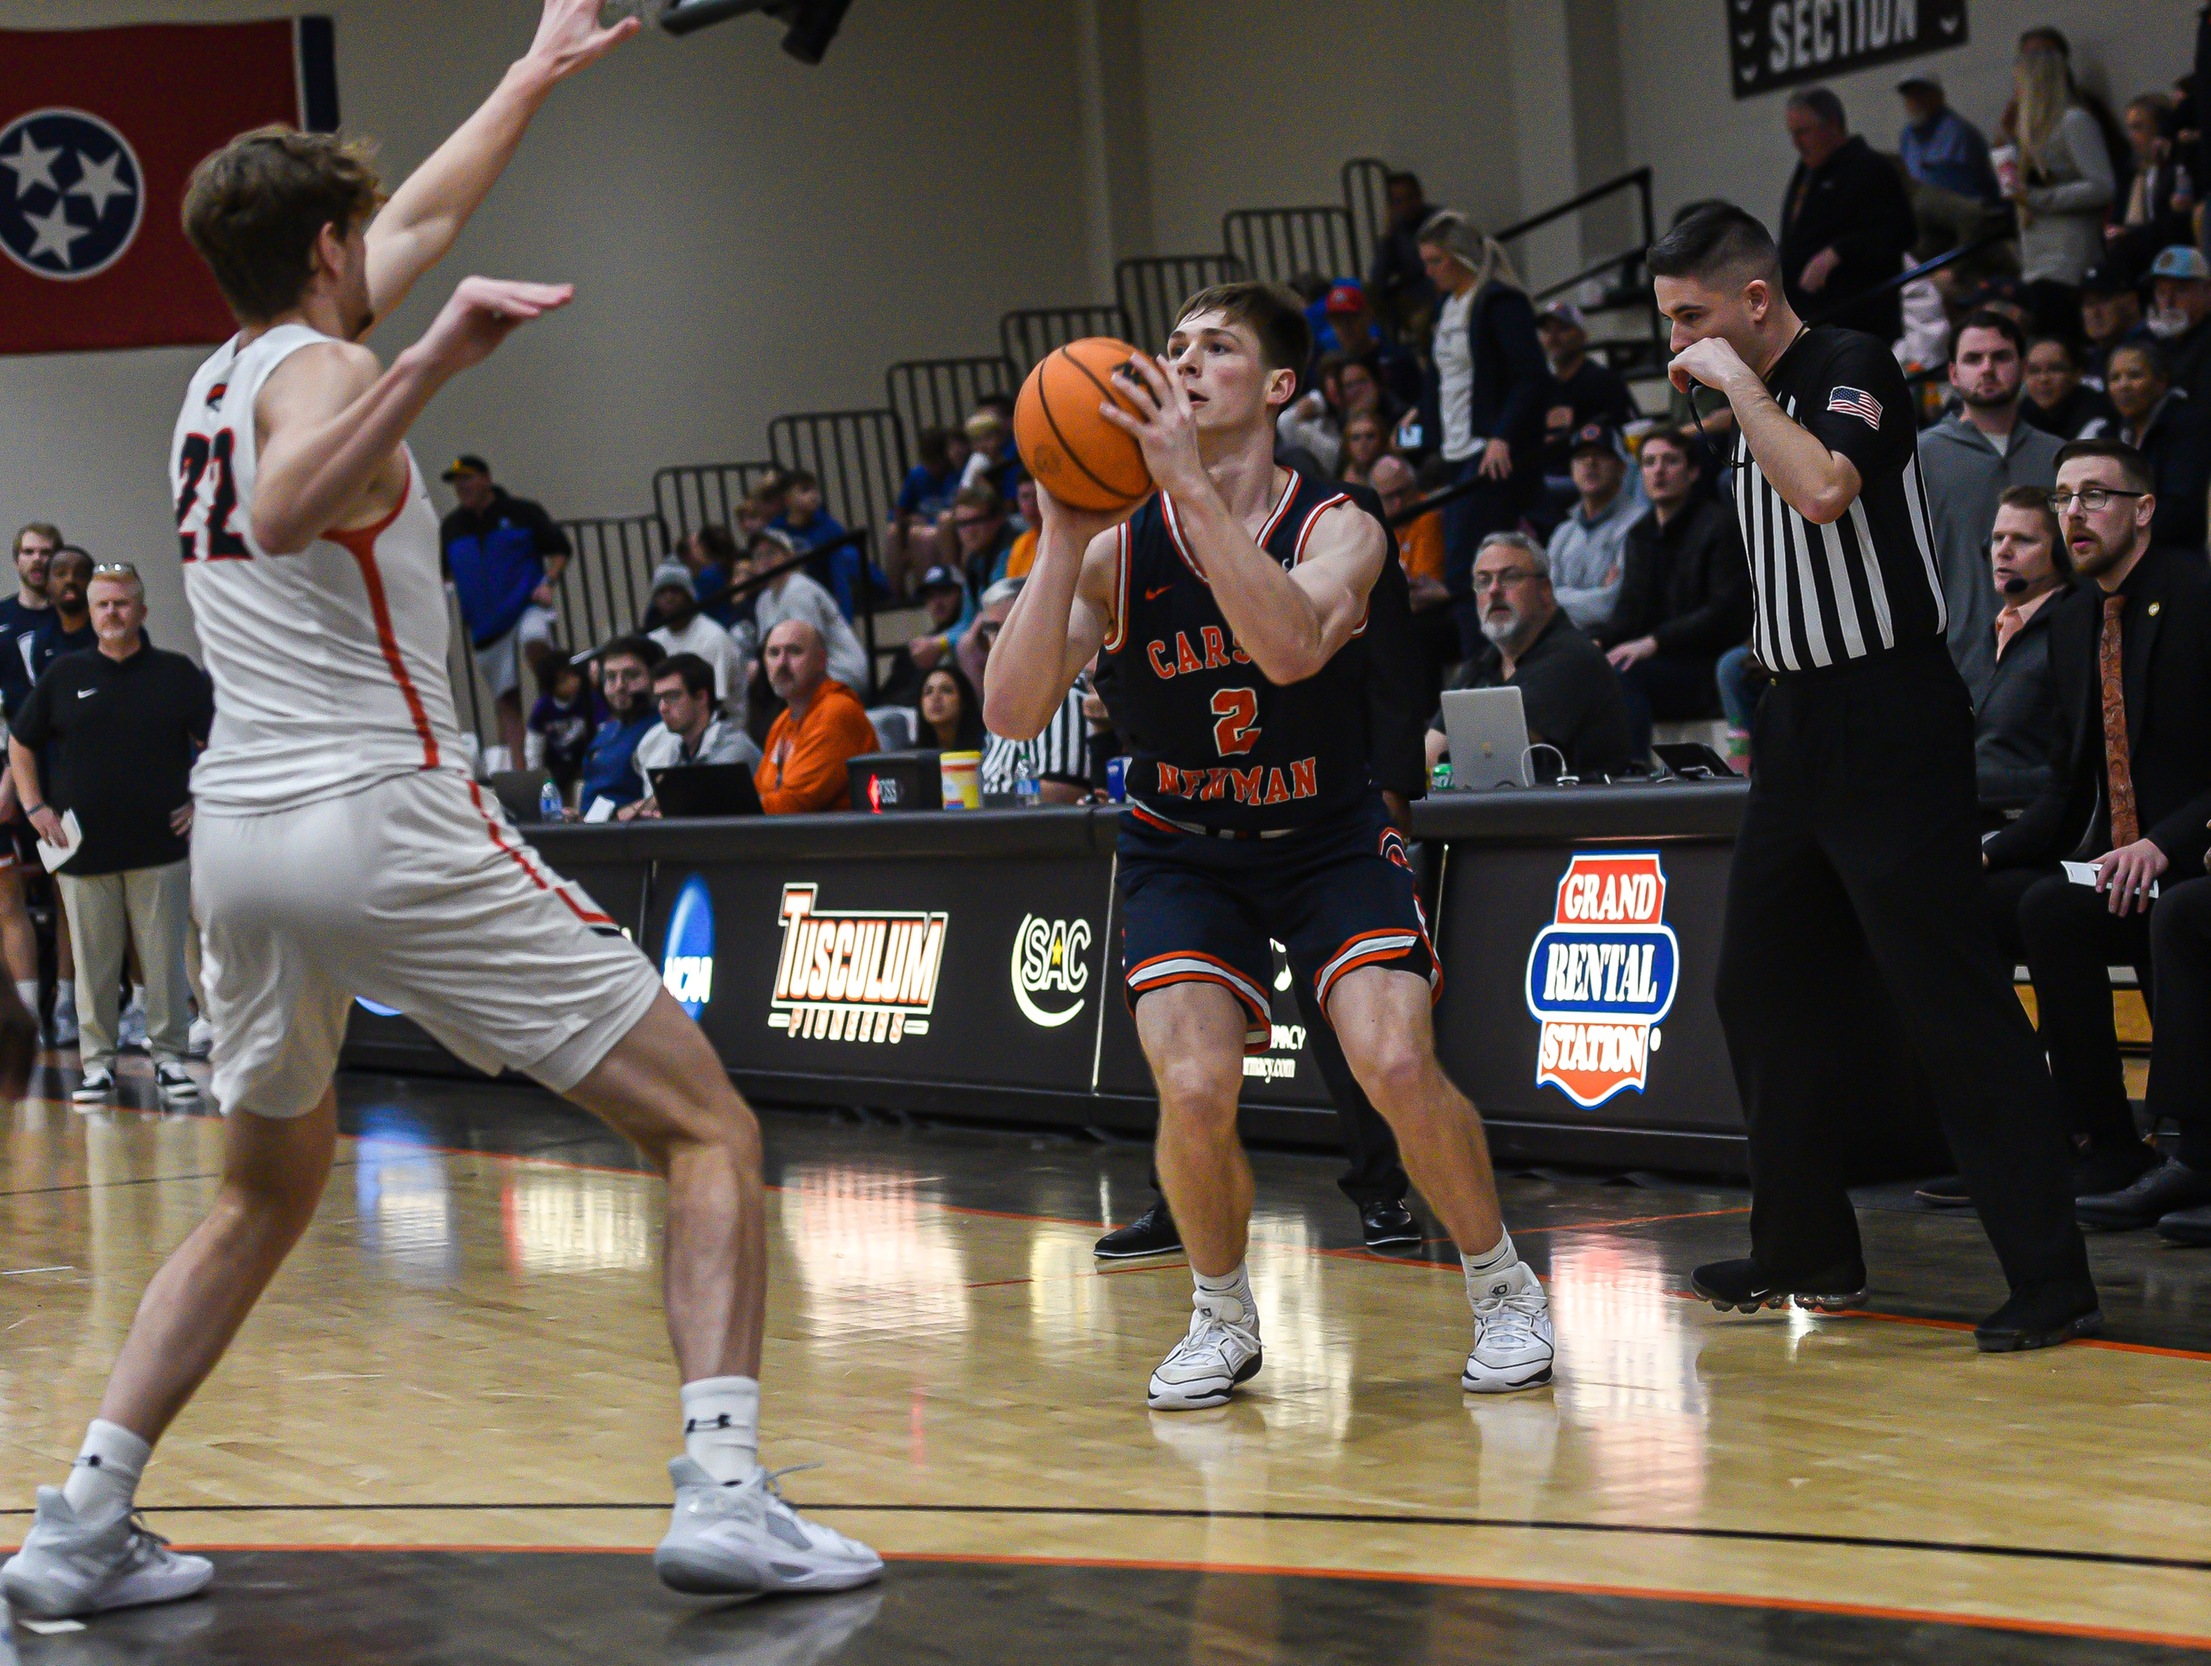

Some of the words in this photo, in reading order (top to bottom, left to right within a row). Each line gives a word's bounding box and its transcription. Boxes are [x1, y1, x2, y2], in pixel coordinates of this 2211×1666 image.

[1768, 0, 1917, 73] SECTION
[1210, 686, 1263, 757] 2
[1157, 756, 1318, 806] NEWMAN
[1564, 873, 1657, 920] GRAND
[775, 887, 945, 1006] TUSCULUM
[1021, 917, 1092, 993] SAC
[1543, 943, 1658, 1003] RENTAL
[1542, 1023, 1647, 1073] STATION
